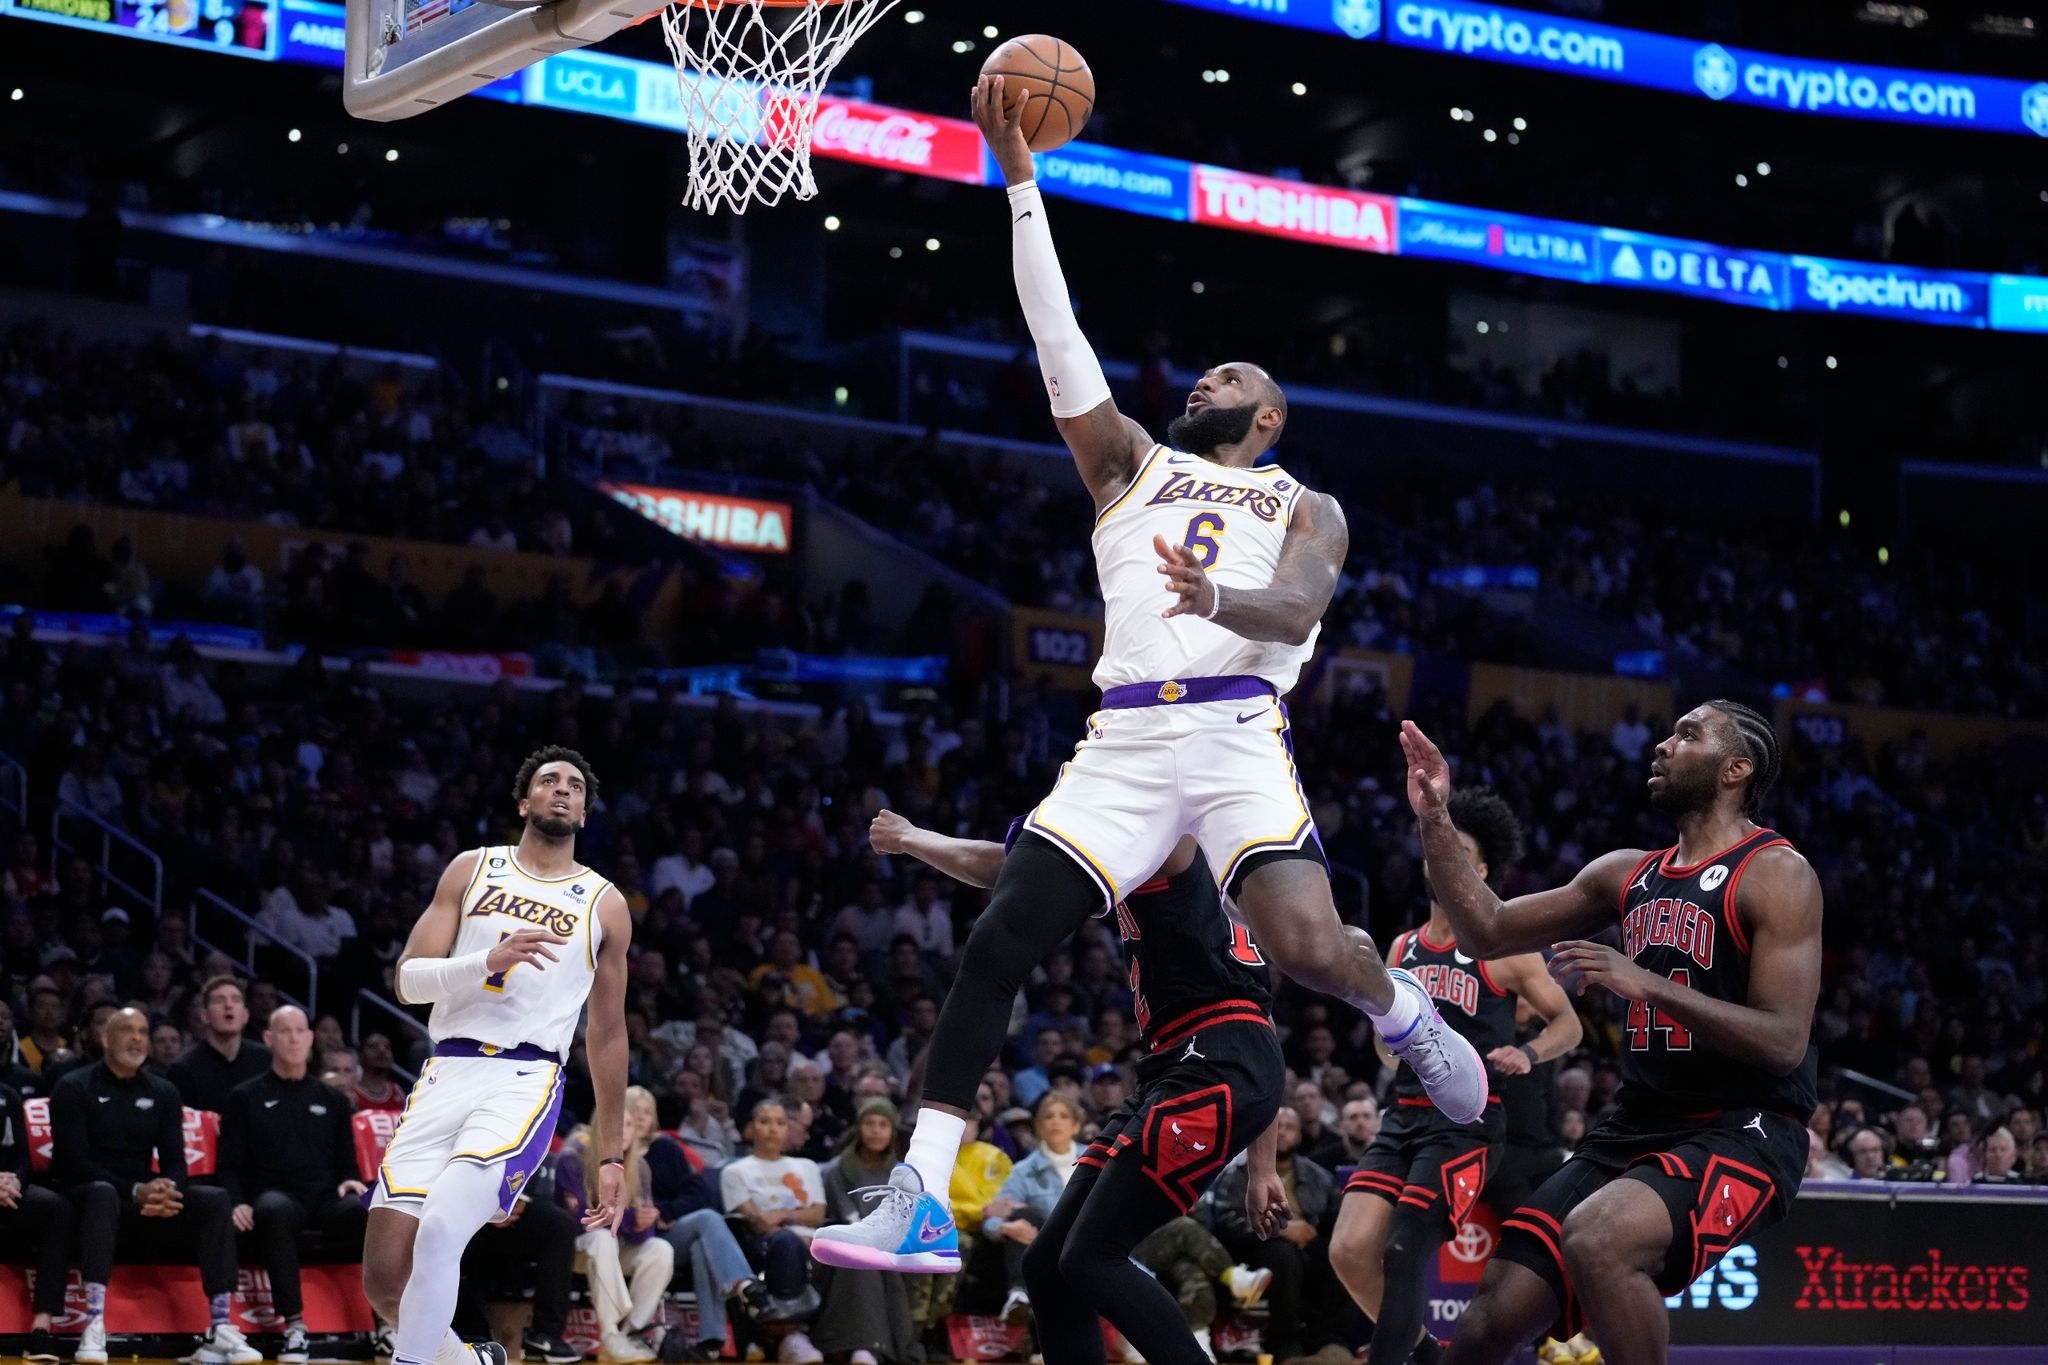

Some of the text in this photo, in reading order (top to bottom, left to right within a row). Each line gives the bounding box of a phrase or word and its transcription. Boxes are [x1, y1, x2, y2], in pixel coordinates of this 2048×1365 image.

[1396, 3, 1624, 71] crypto.com
[555, 68, 626, 99] UCLA
[1744, 63, 1976, 119] crypto.com
[1045, 157, 1173, 199] crypto.com
[1200, 179, 1389, 243] TOSHIBA
[1504, 230, 1588, 265] ULTRA
[1651, 248, 1774, 294] DELTA
[1806, 262, 1963, 314] Spectrum
[1145, 471, 1281, 523] LAKERS
[1182, 511, 1226, 573] 6
[467, 884, 580, 938] LAKERS
[563, 889, 587, 905] bibigo
[1623, 897, 1716, 971] CHICAGO
[1795, 1246, 2029, 1311] Xtrackers
[1429, 1299, 1472, 1322] TOY
